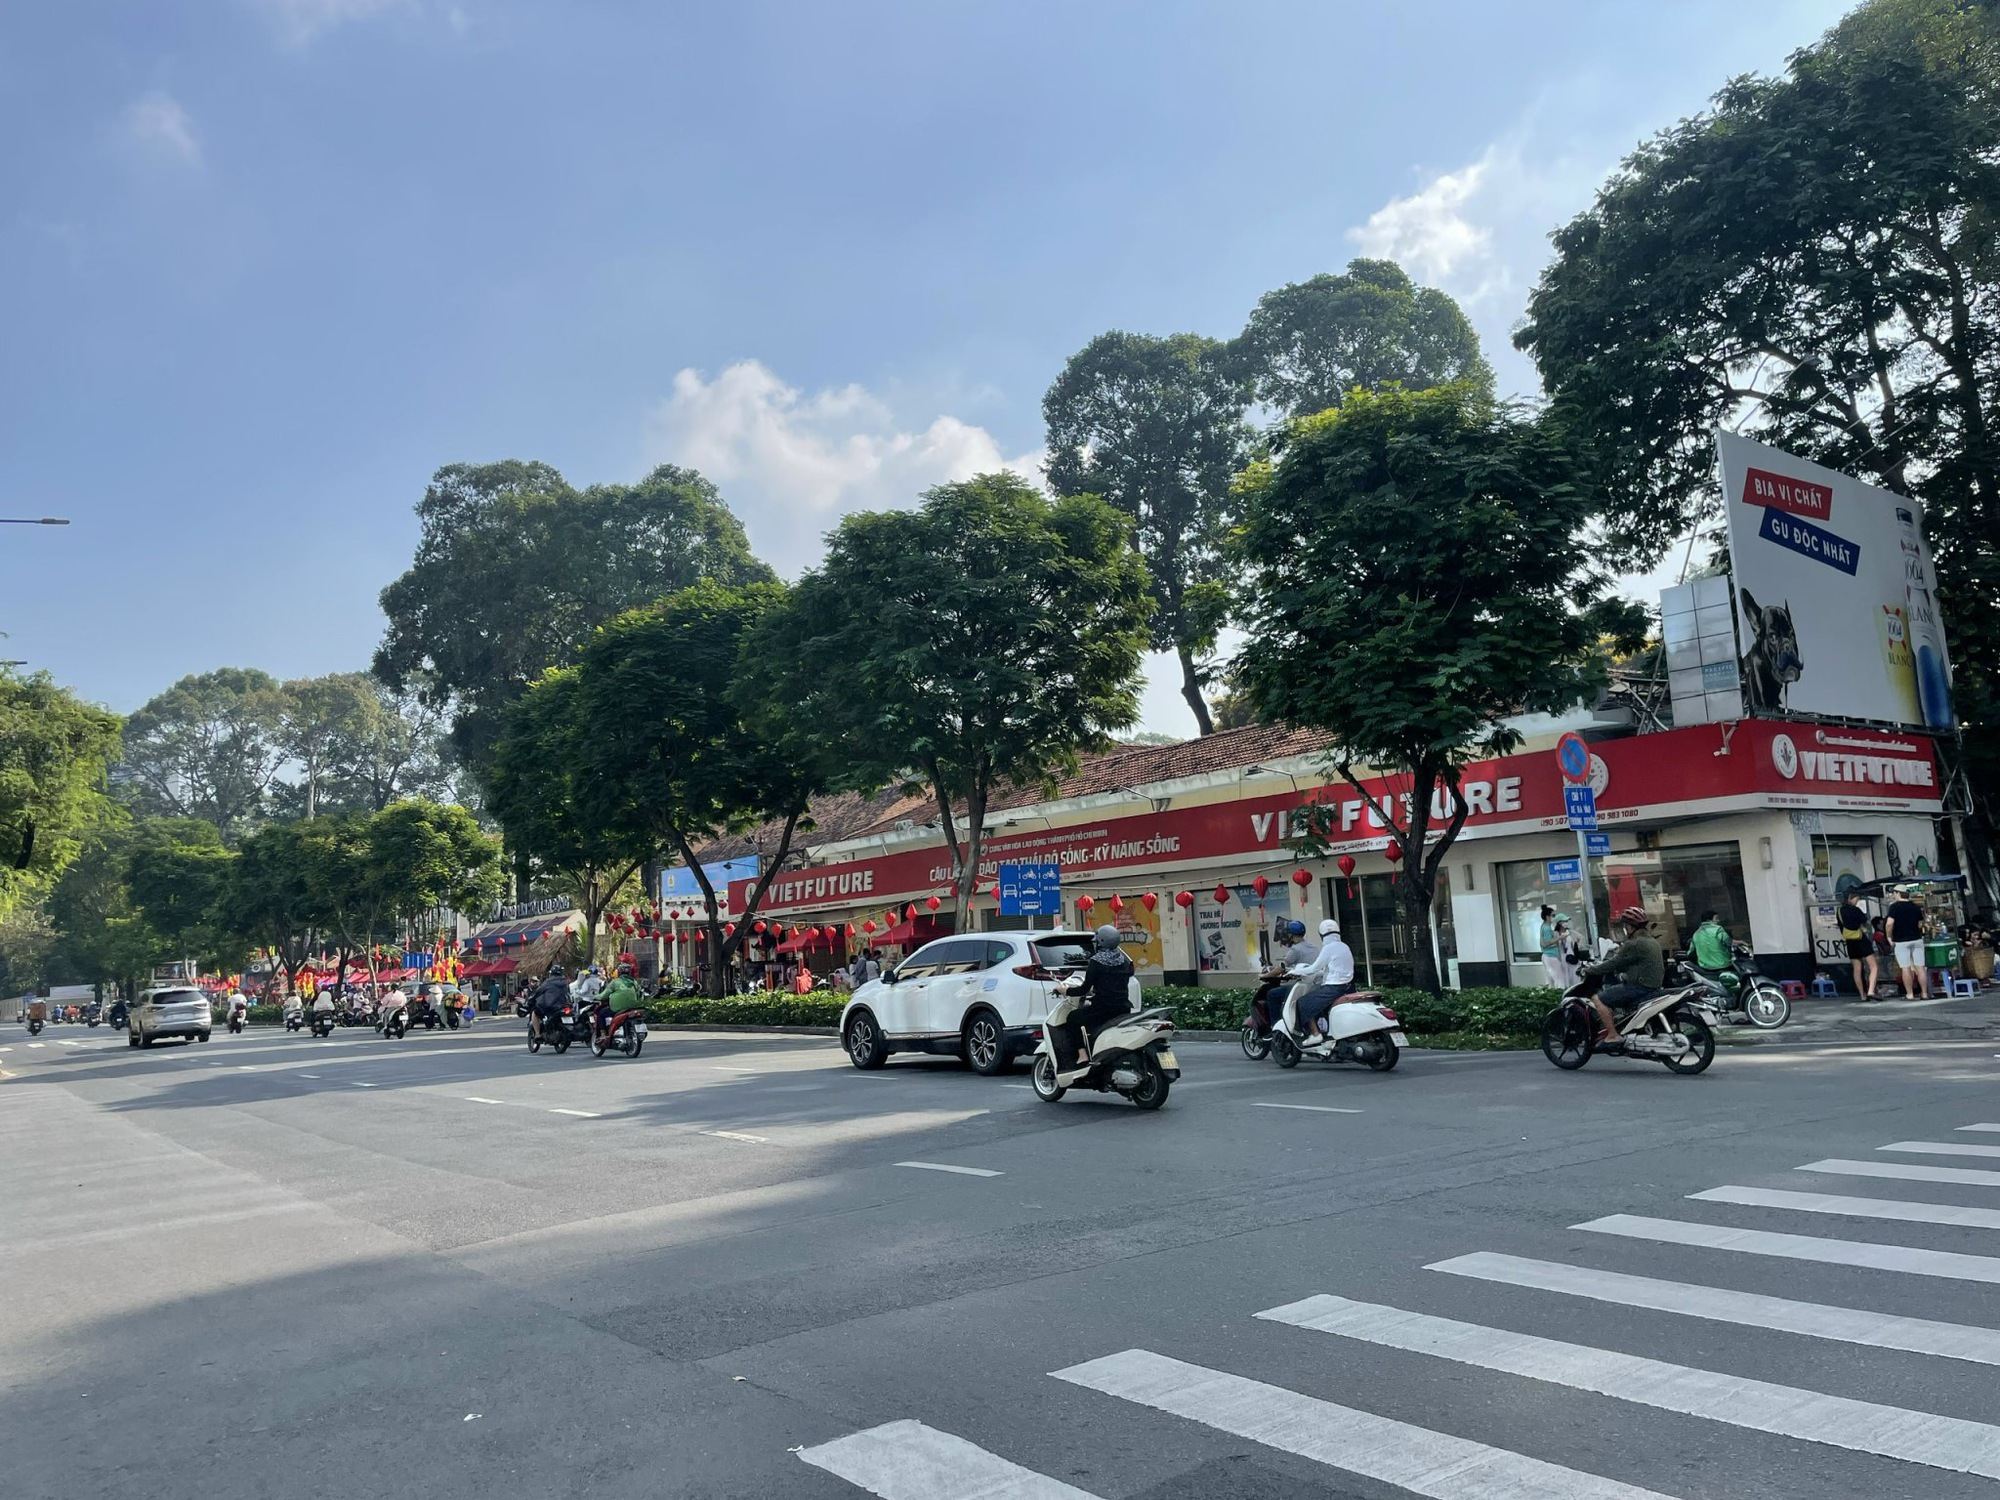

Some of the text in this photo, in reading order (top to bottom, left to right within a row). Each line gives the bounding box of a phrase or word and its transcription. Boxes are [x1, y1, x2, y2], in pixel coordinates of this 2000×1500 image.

[1755, 478, 1822, 508] BIA VỊ CHẤT
[1772, 518, 1850, 565] GU ĐỘC NHẤT
[1799, 751, 1933, 786] VIETFUTURE
[1607, 811, 1620, 820] 983
[1621, 809, 1638, 817] 1080
[979, 859, 998, 875] ĐÀO
[1111, 840, 1145, 860] NĂNG
[1147, 832, 1180, 855] SỐNG
[769, 870, 873, 904] VIETFUTURE
